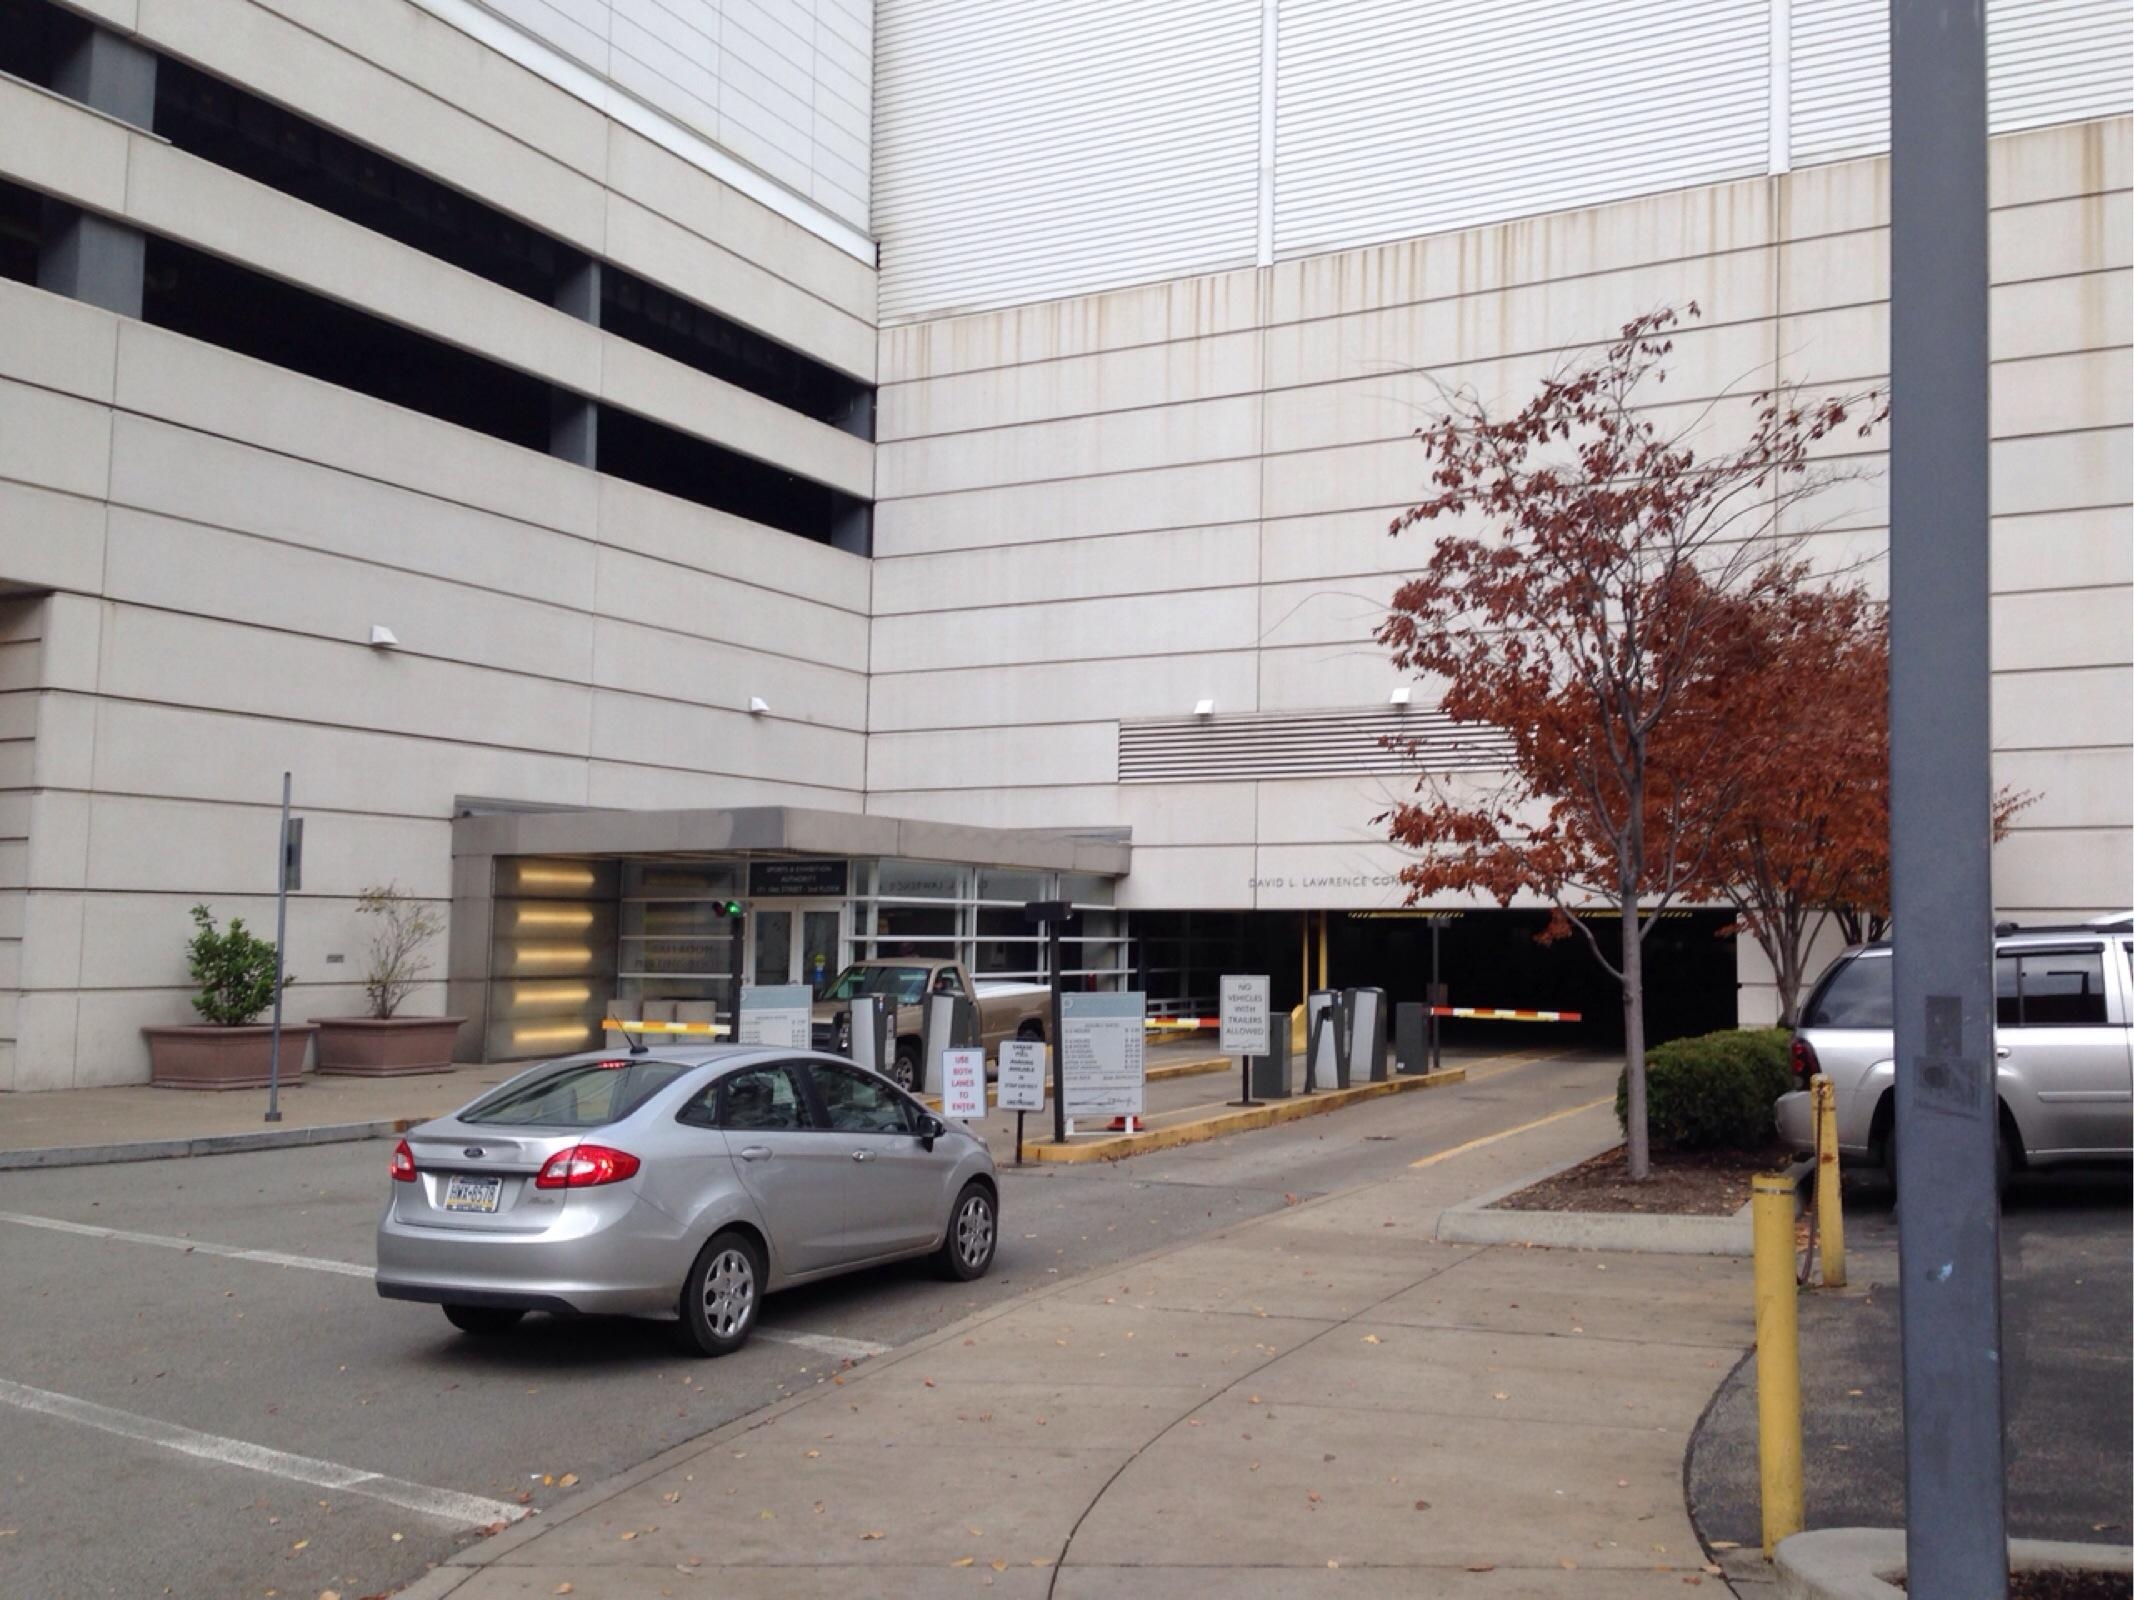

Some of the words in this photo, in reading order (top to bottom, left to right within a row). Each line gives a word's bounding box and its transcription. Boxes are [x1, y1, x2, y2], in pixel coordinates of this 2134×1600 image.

[1248, 877, 1284, 889] DAVID
[1302, 875, 1368, 888] LAWRENCE
[1236, 982, 1252, 992] NO
[1228, 994, 1263, 1002] VEHICLES
[1234, 1005, 1256, 1013] WITH
[1227, 1016, 1263, 1024] TRAILERS
[1226, 1027, 1265, 1036] ALLOWED
[954, 1055, 969, 1064] USE
[952, 1067, 973, 1076] BOTH
[951, 1079, 975, 1088] LANES
[959, 1091, 969, 1099] TO
[952, 1102, 976, 1111] ENTER
